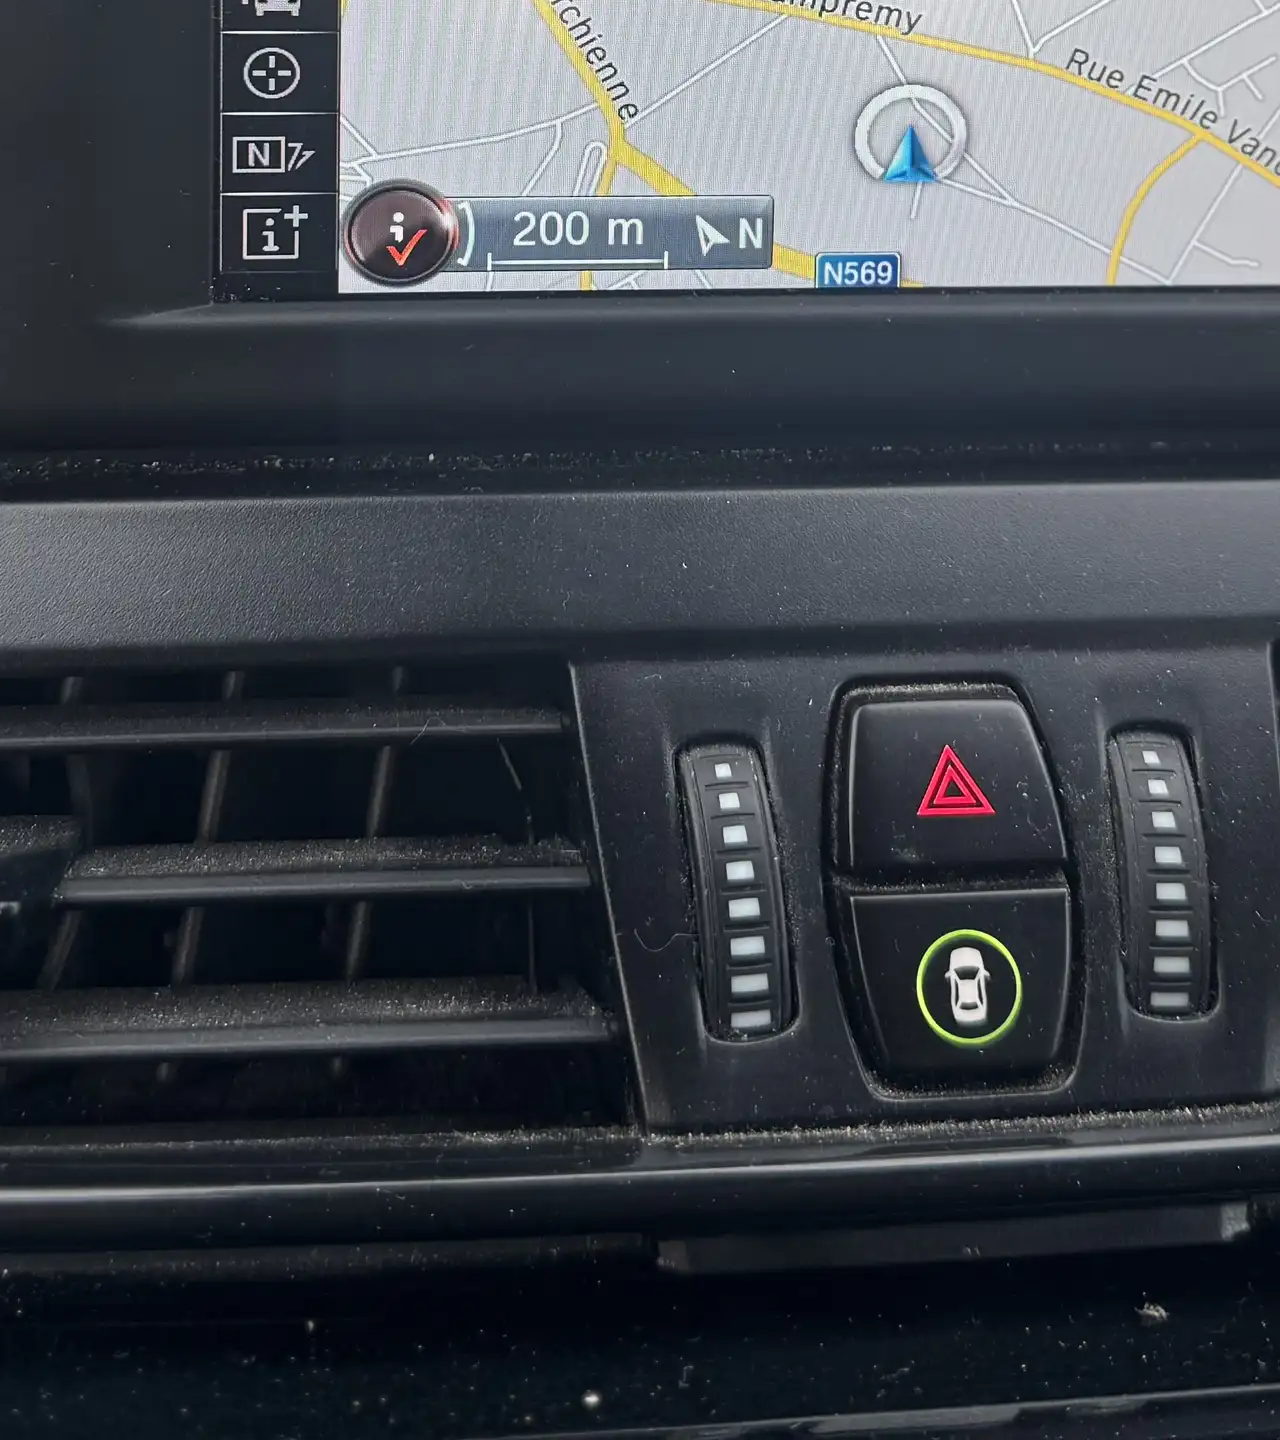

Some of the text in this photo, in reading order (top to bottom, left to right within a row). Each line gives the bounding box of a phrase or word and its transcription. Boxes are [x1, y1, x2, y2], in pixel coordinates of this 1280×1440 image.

[1065, 48, 1125, 89] Rue
[1132, 74, 1219, 130] Emile
[513, 210, 645, 246] 200 m
[738, 217, 763, 249] N
[823, 261, 893, 287] N569
